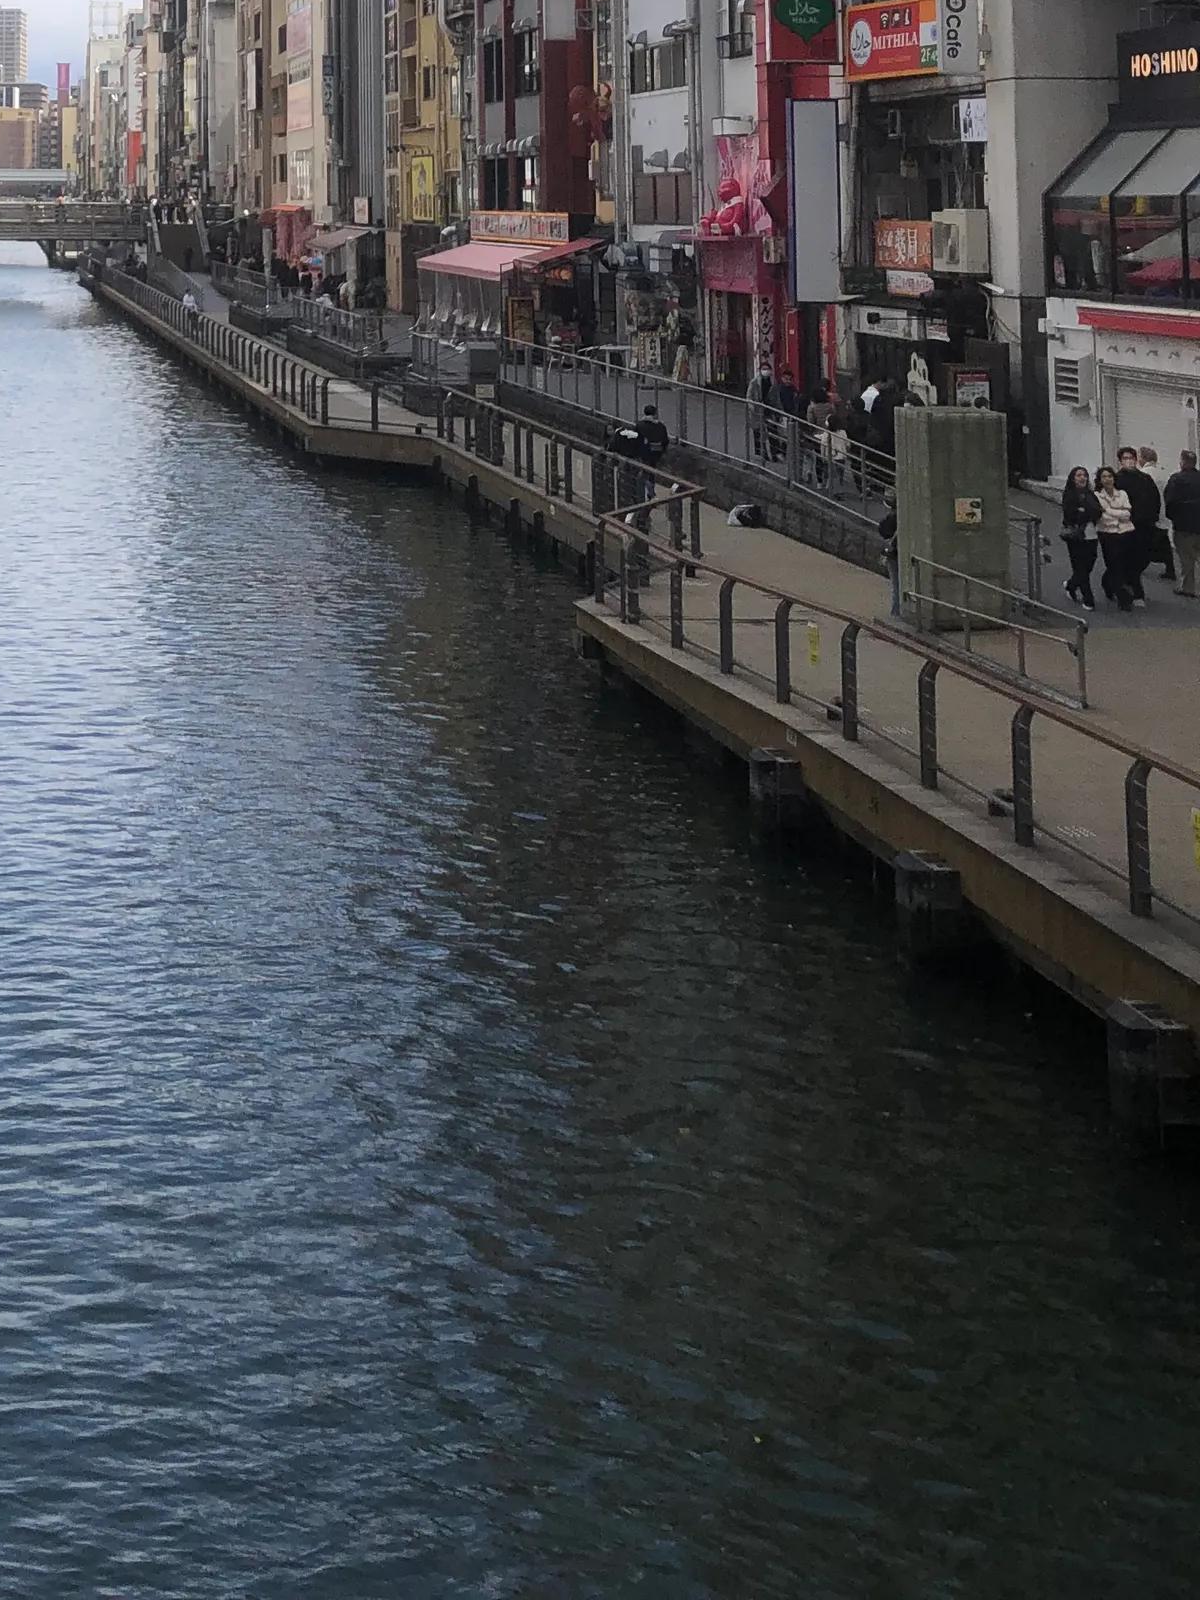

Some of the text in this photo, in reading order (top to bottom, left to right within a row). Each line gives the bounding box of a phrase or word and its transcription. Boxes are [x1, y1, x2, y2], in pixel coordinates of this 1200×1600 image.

[872, 31, 919, 51] MITHILA
[945, 13, 962, 60] cafe
[1131, 47, 1198, 78] HOSHINO
